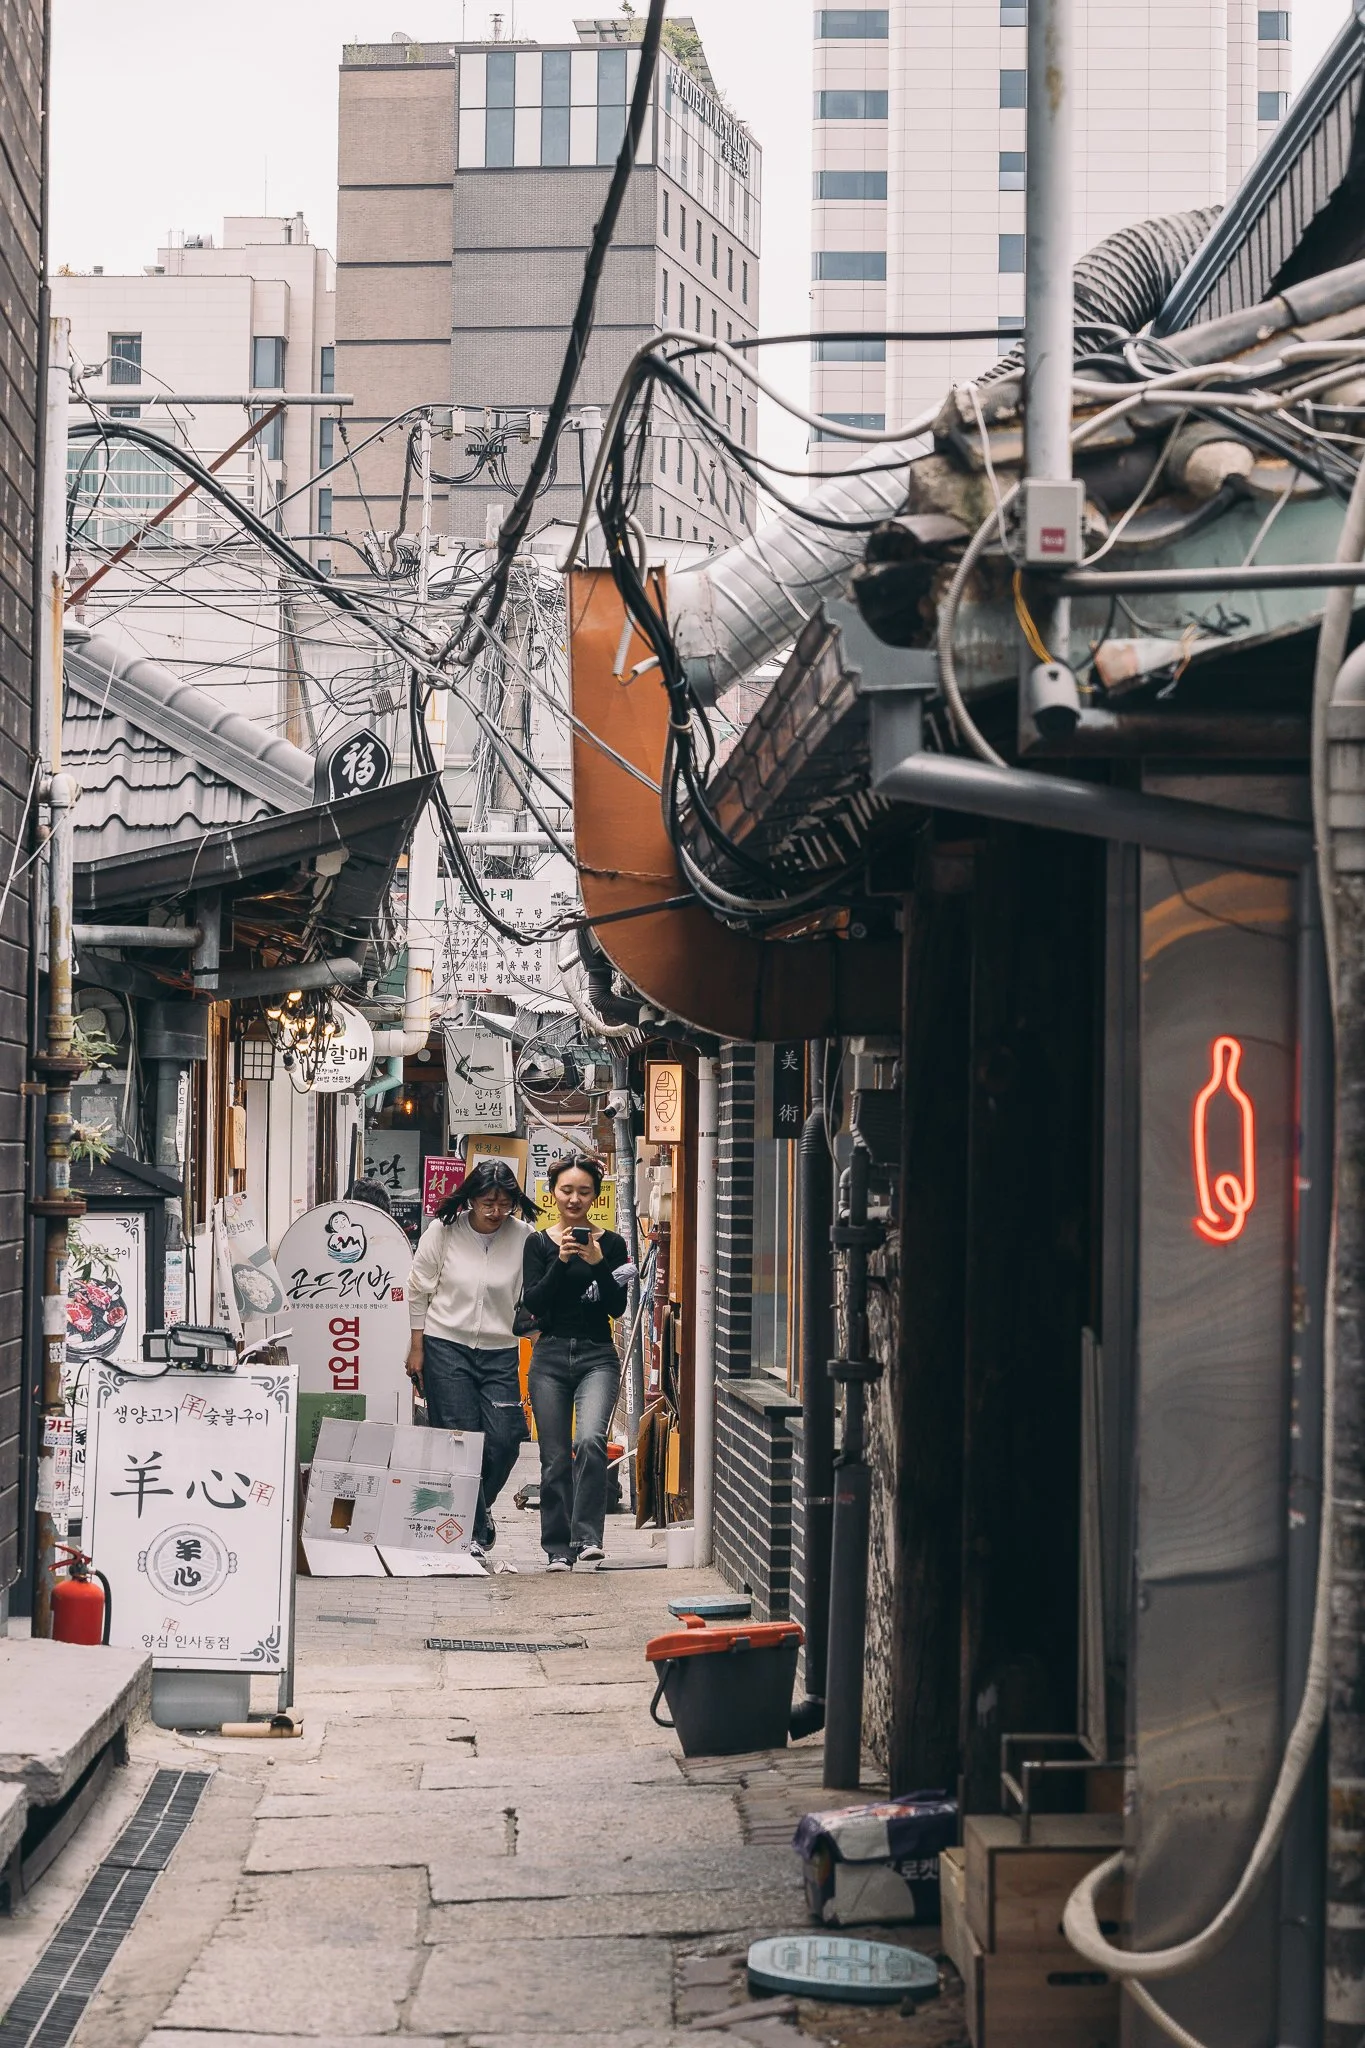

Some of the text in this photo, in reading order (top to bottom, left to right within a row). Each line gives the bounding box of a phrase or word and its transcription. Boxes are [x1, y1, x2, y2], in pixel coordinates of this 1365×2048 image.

[497, 908, 543, 919] 대구탕
[496, 960, 542, 972] 제육볶음
[475, 1089, 502, 1100] 인사동
[779, 1051, 799, 1123] 美術
[475, 1102, 503, 1117] 보쌈
[286, 1265, 396, 1301] 곤드레밥
[328, 1316, 360, 1391] 영업
[112, 1405, 269, 1427] 생양고기 숯불구이
[141, 1633, 231, 1651] 양심 인사동점
